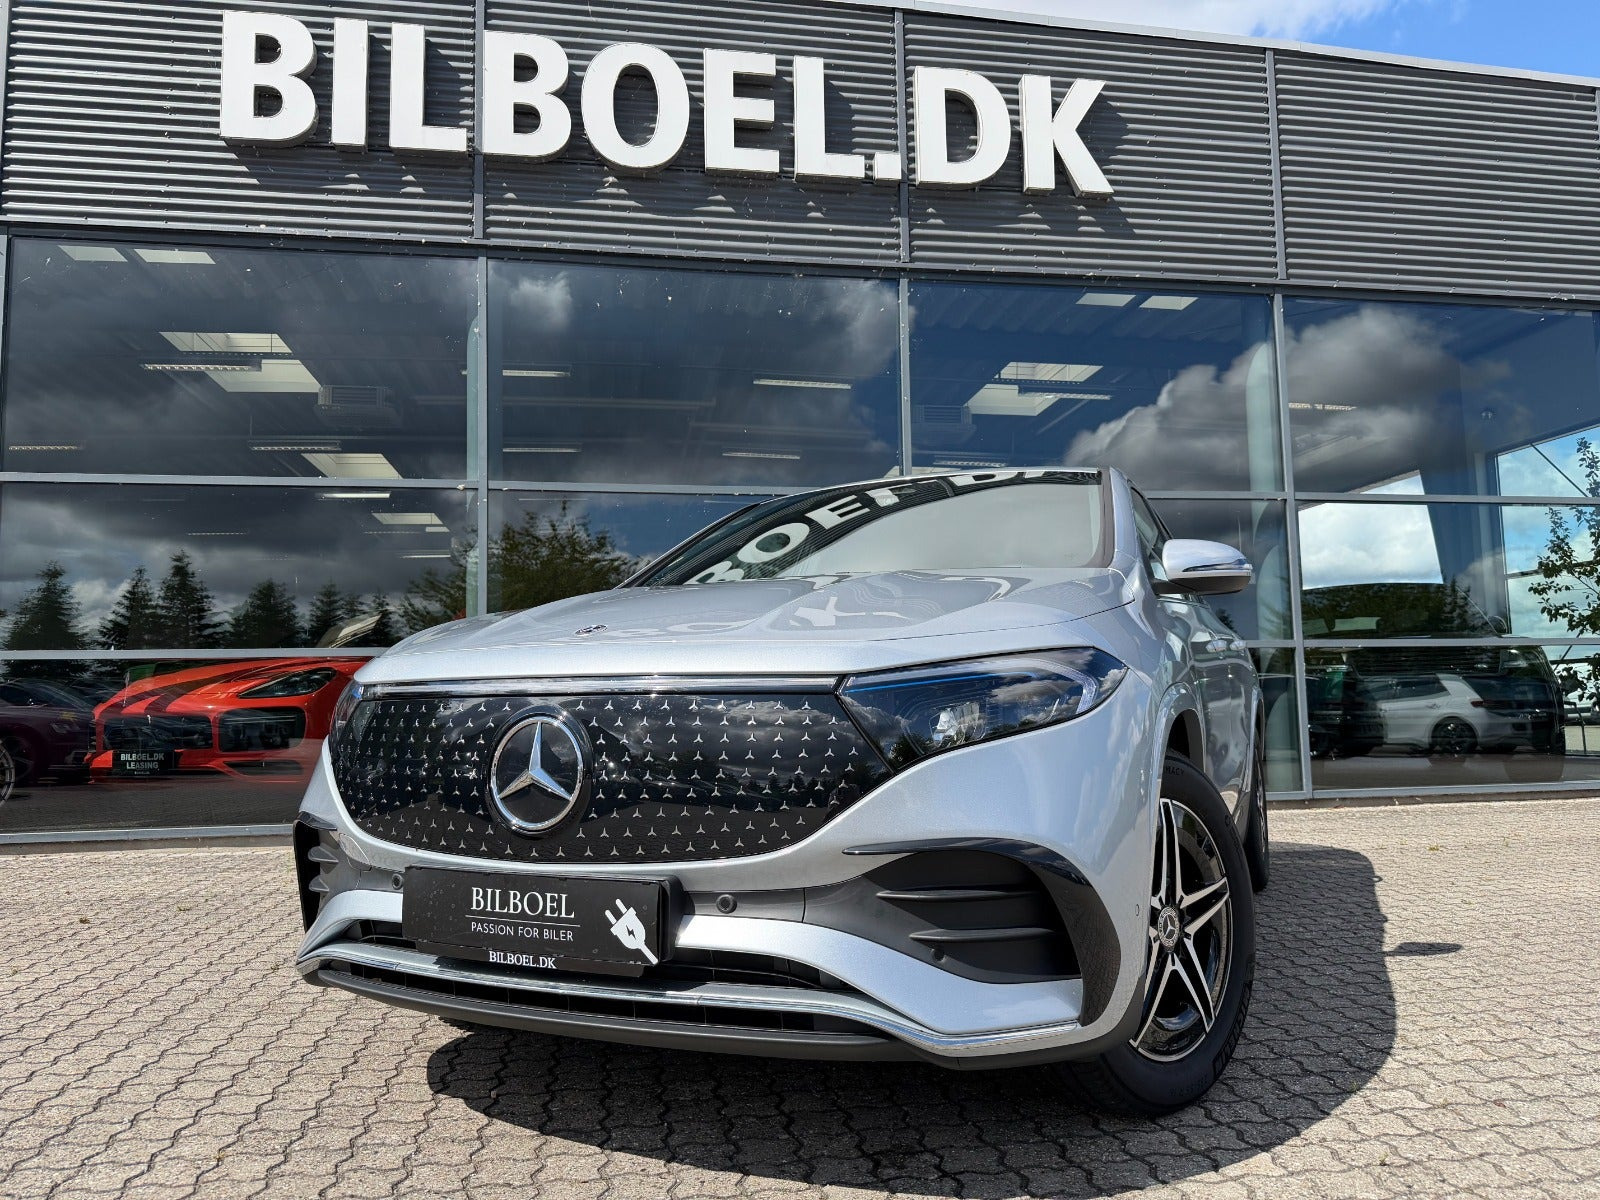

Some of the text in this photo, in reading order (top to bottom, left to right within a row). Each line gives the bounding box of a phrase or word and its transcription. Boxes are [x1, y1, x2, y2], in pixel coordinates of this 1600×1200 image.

[219, 9, 1114, 198] BILBOEL.DK
[120, 753, 165, 761] BILBOEL.DK
[126, 761, 159, 769] LEASING
[470, 886, 575, 919] BILBOEL
[471, 921, 574, 942] PASSION FOR BILER
[488, 950, 557, 969] BILBOEL.DK
